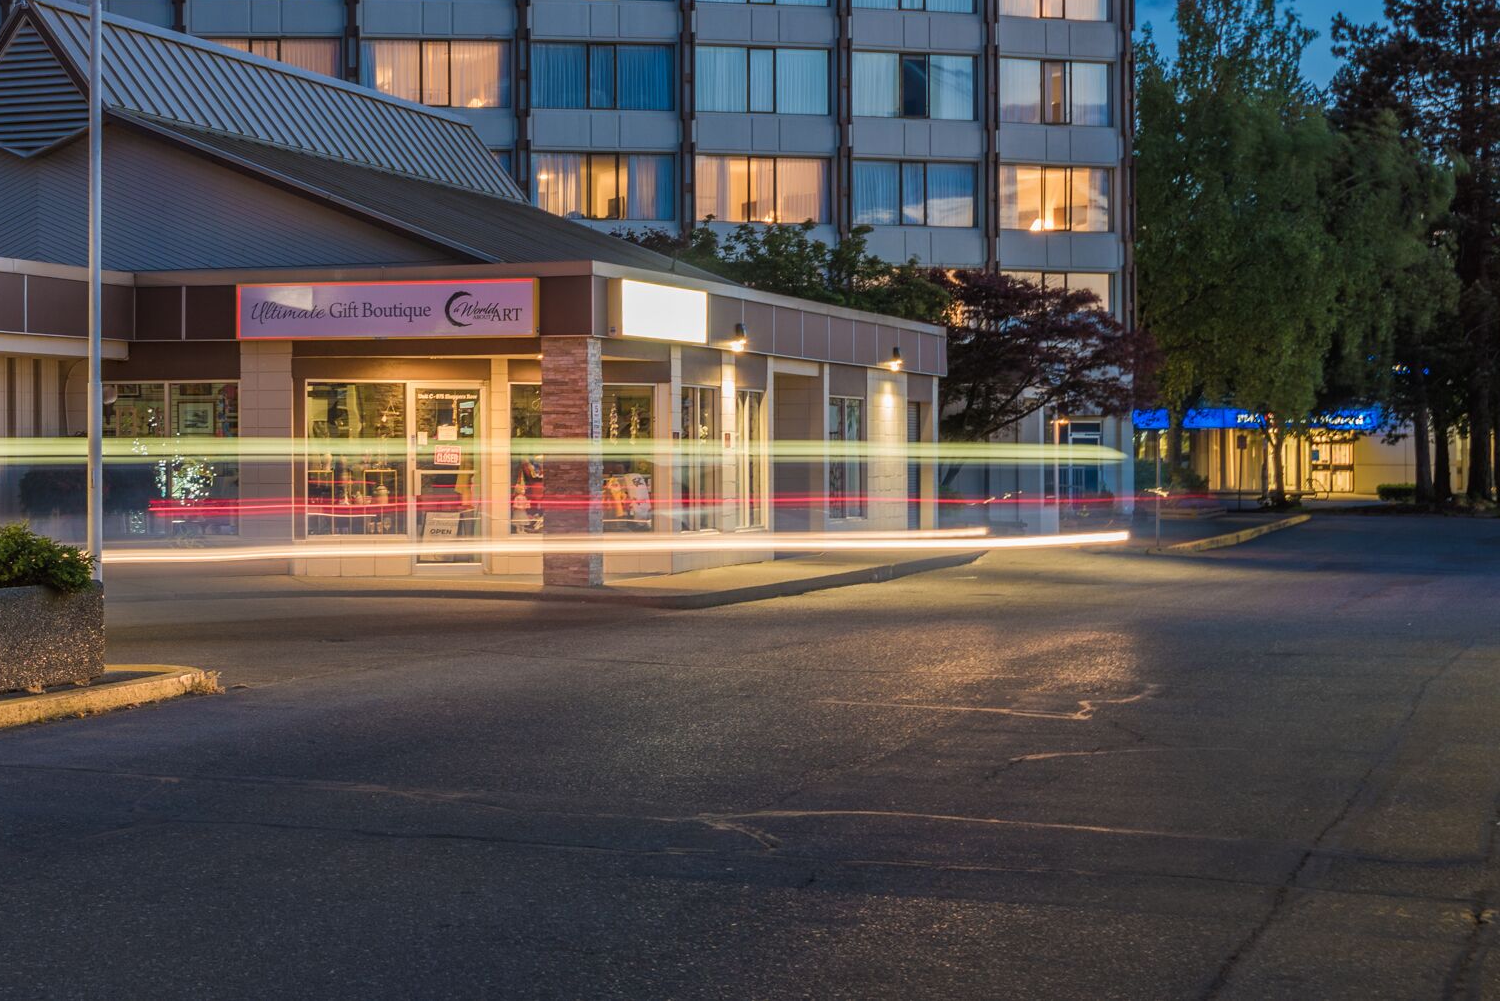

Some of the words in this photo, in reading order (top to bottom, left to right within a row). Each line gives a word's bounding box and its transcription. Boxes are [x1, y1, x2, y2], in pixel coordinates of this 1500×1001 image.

[251, 301, 326, 325] Ultimate
[329, 302, 359, 319] Gift
[362, 302, 432, 323] Boutique
[457, 300, 500, 318] World
[490, 307, 523, 322] ART
[436, 453, 459, 464] CLOSED
